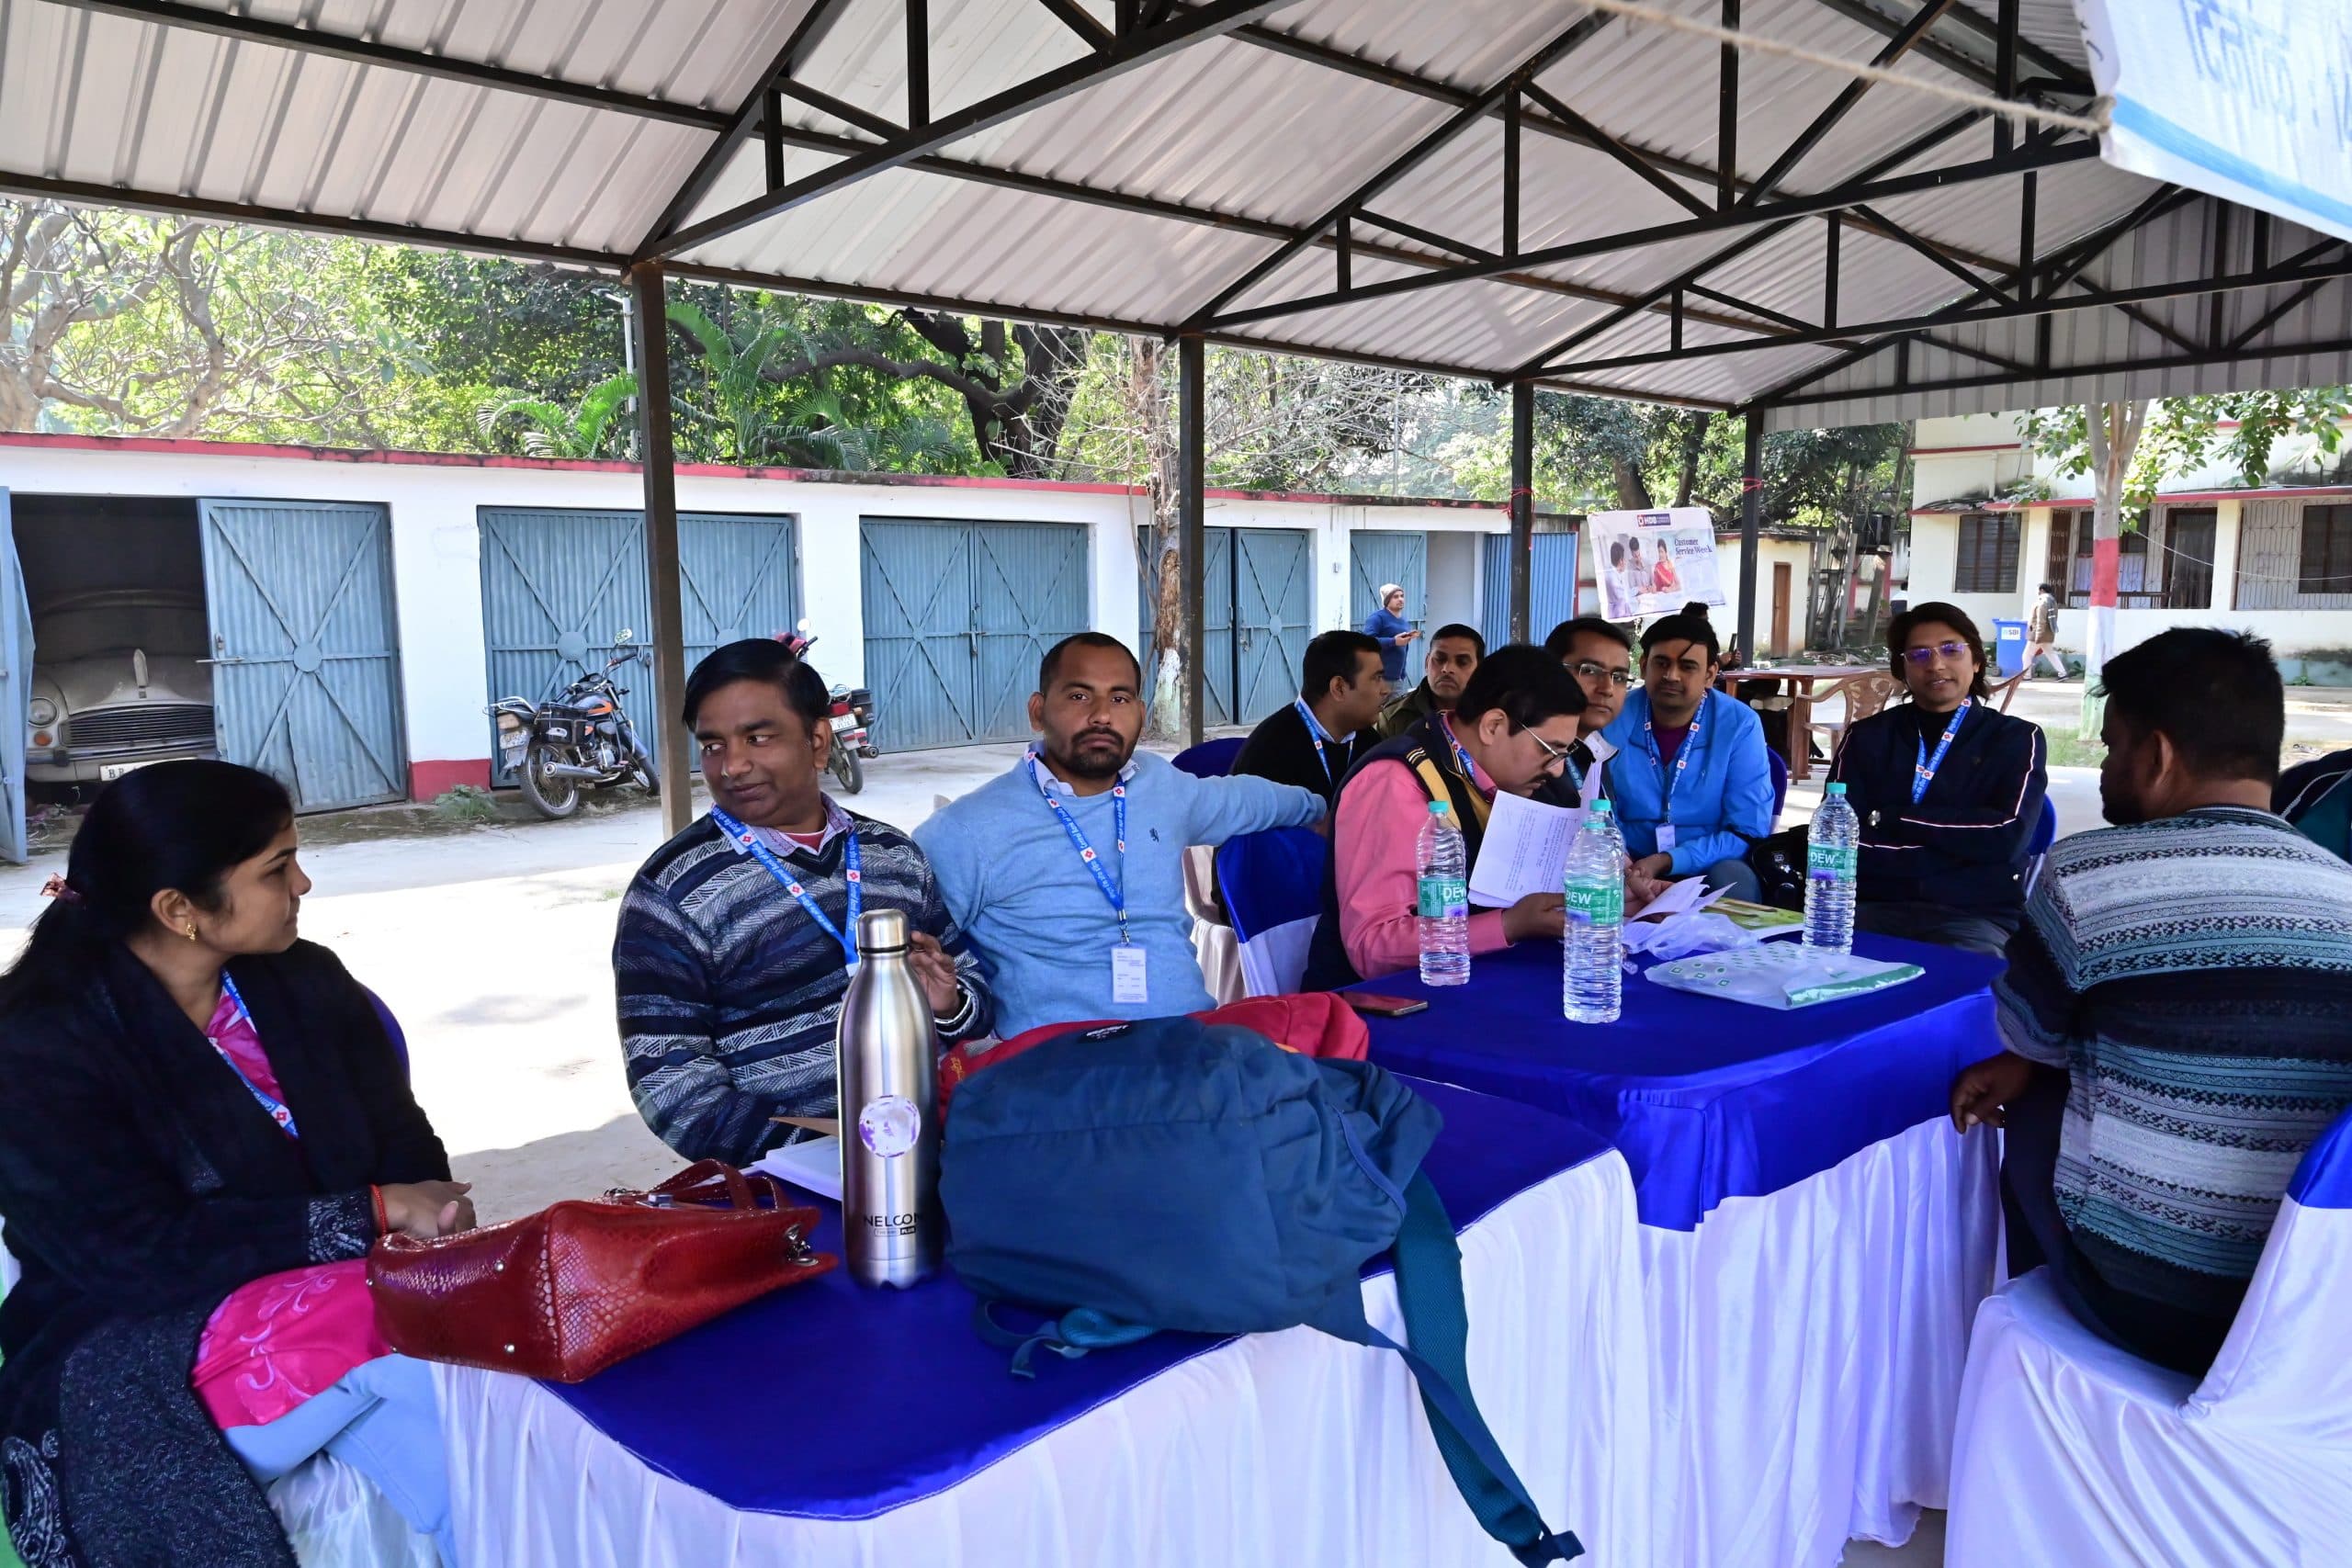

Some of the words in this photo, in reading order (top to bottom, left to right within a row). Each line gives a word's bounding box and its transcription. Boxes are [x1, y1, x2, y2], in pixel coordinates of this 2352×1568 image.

[1676, 547, 1694, 555] Service
[1694, 545, 1713, 553] Week
[1810, 852, 1836, 864] DEW
